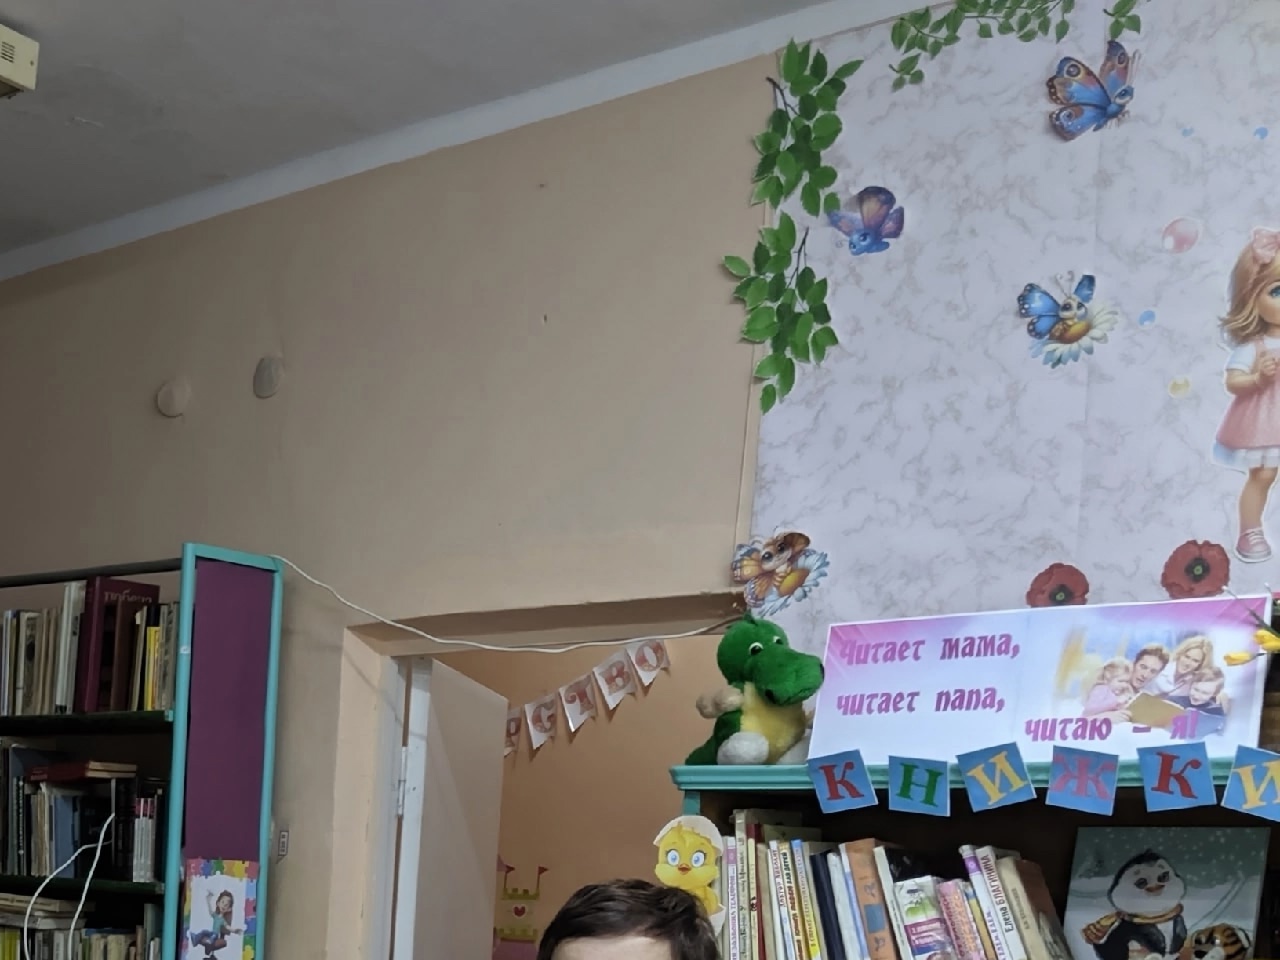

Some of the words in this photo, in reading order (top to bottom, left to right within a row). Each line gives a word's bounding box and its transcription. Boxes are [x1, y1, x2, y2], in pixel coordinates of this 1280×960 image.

[839, 636, 925, 666] Читает
[939, 632, 1020, 661] мама,
[836, 689, 921, 716] читает
[934, 686, 1005, 713] папа,
[1025, 717, 1112, 742] читаю
[1170, 713, 1198, 741] я!
[979, 853, 1005, 906] БЛАГИНИНА
[997, 905, 1015, 933] Елена
